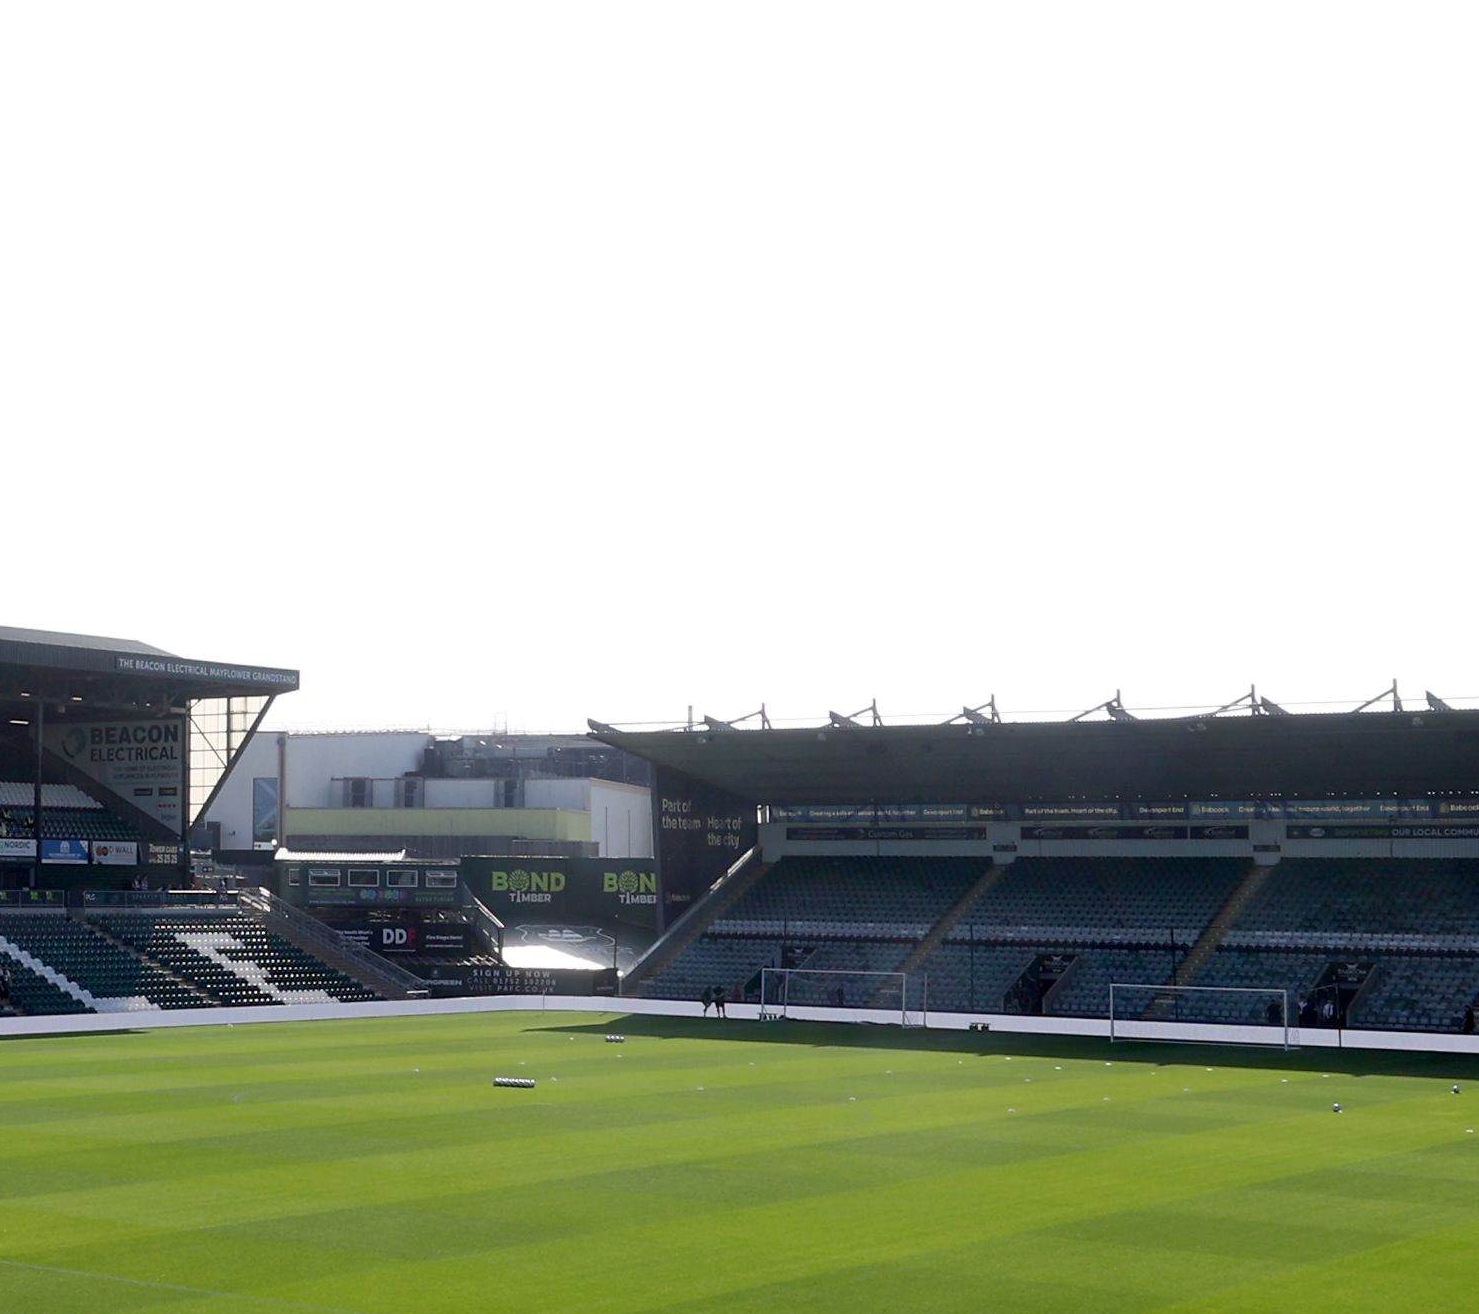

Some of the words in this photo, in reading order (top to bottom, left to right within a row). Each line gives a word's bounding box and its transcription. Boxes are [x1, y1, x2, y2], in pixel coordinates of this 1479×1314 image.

[119, 659, 134, 669] THE
[136, 660, 165, 671] BEACON
[167, 663, 208, 676] ELECTRICAL
[210, 667, 250, 680] MAYFLOWER
[252, 671, 296, 684] GRANDSTAND
[90, 724, 178, 744] BEACON
[91, 746, 178, 762] ELECTRICAL
[662, 798, 680, 812] Part
[662, 815, 677, 829] the
[678, 816, 701, 829] team
[708, 816, 731, 829] Heart
[732, 816, 741, 830] of
[4, 841, 30, 849] NORDIC
[708, 833, 721, 846] the
[723, 833, 740, 849] city
[492, 868, 565, 892] BOND
[509, 891, 551, 903] TIMBER
[473, 969, 500, 977] SIGN
[467, 977, 489, 985] CALL
